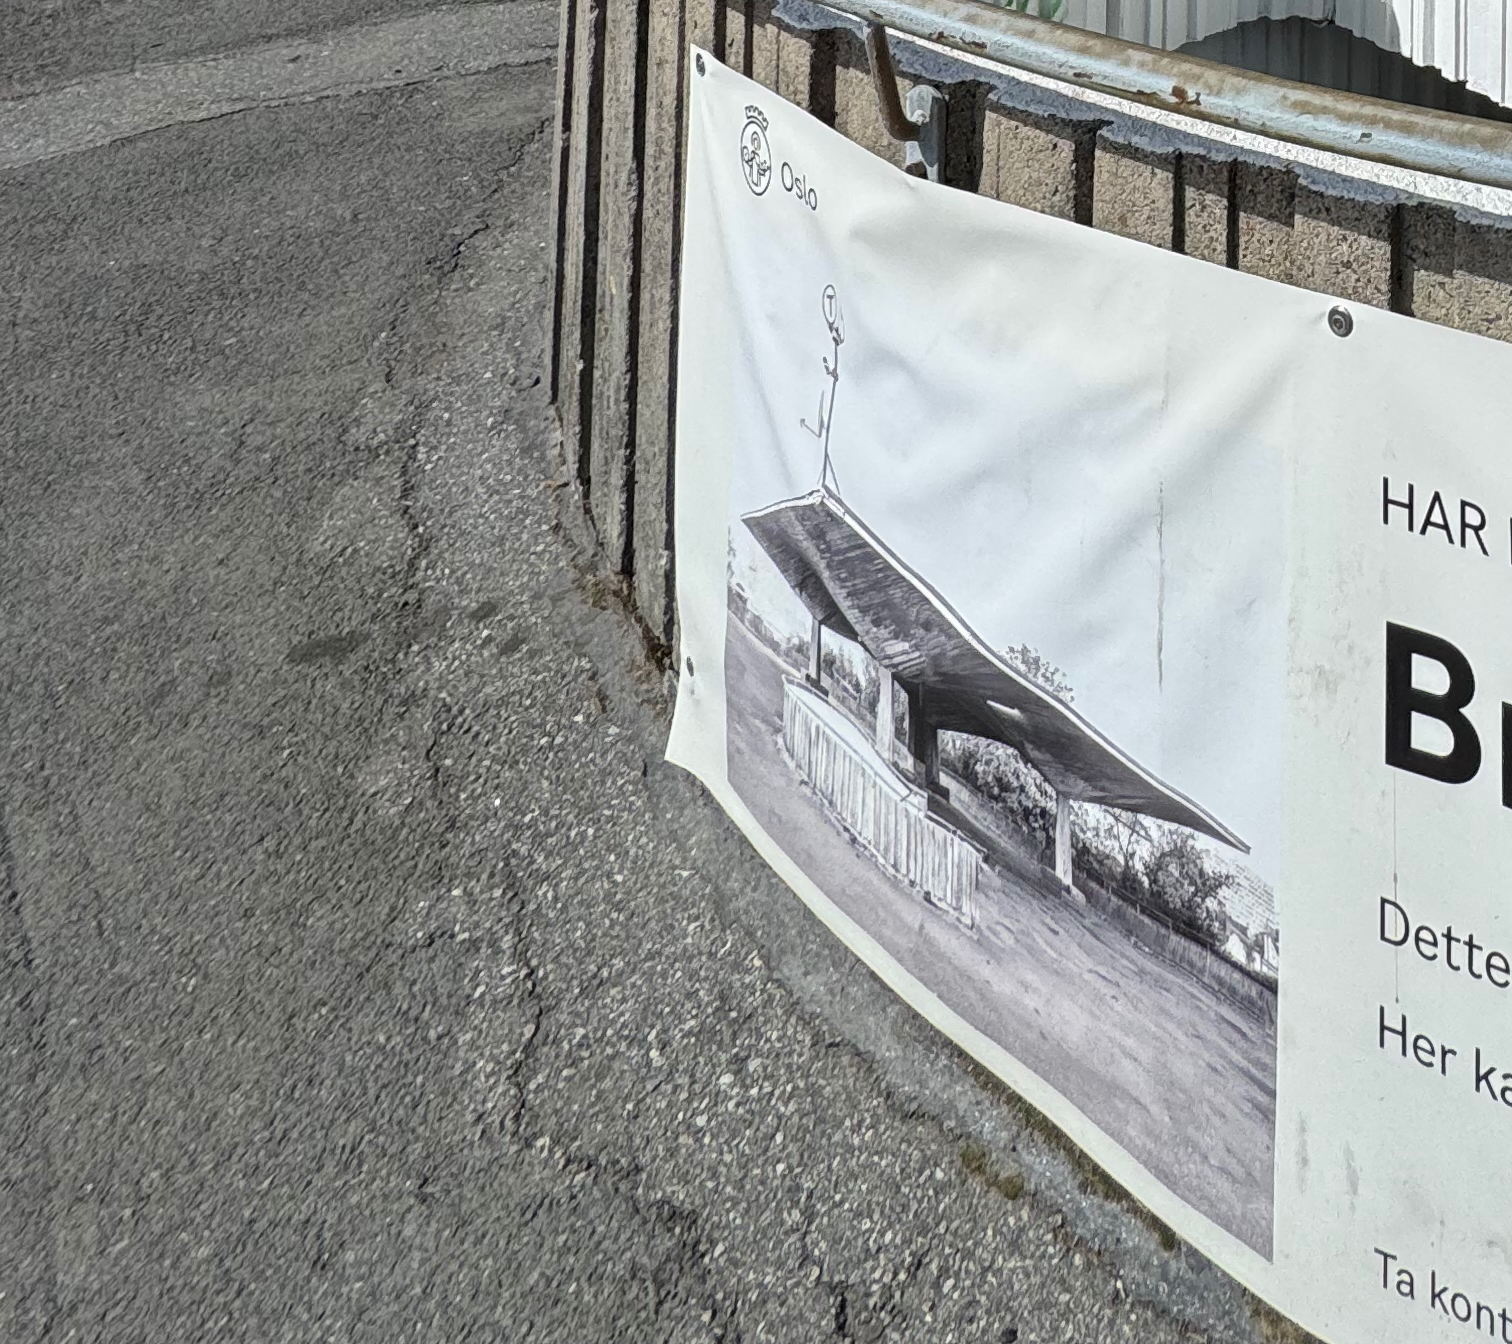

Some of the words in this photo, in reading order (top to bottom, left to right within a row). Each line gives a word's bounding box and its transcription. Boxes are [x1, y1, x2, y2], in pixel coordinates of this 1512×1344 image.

[780, 161, 818, 211] Oslo
[1382, 476, 1489, 557] HAR
[1380, 896, 1511, 988] Dette
[1379, 1005, 1457, 1075] Her
[1374, 1248, 1415, 1300] Ta
